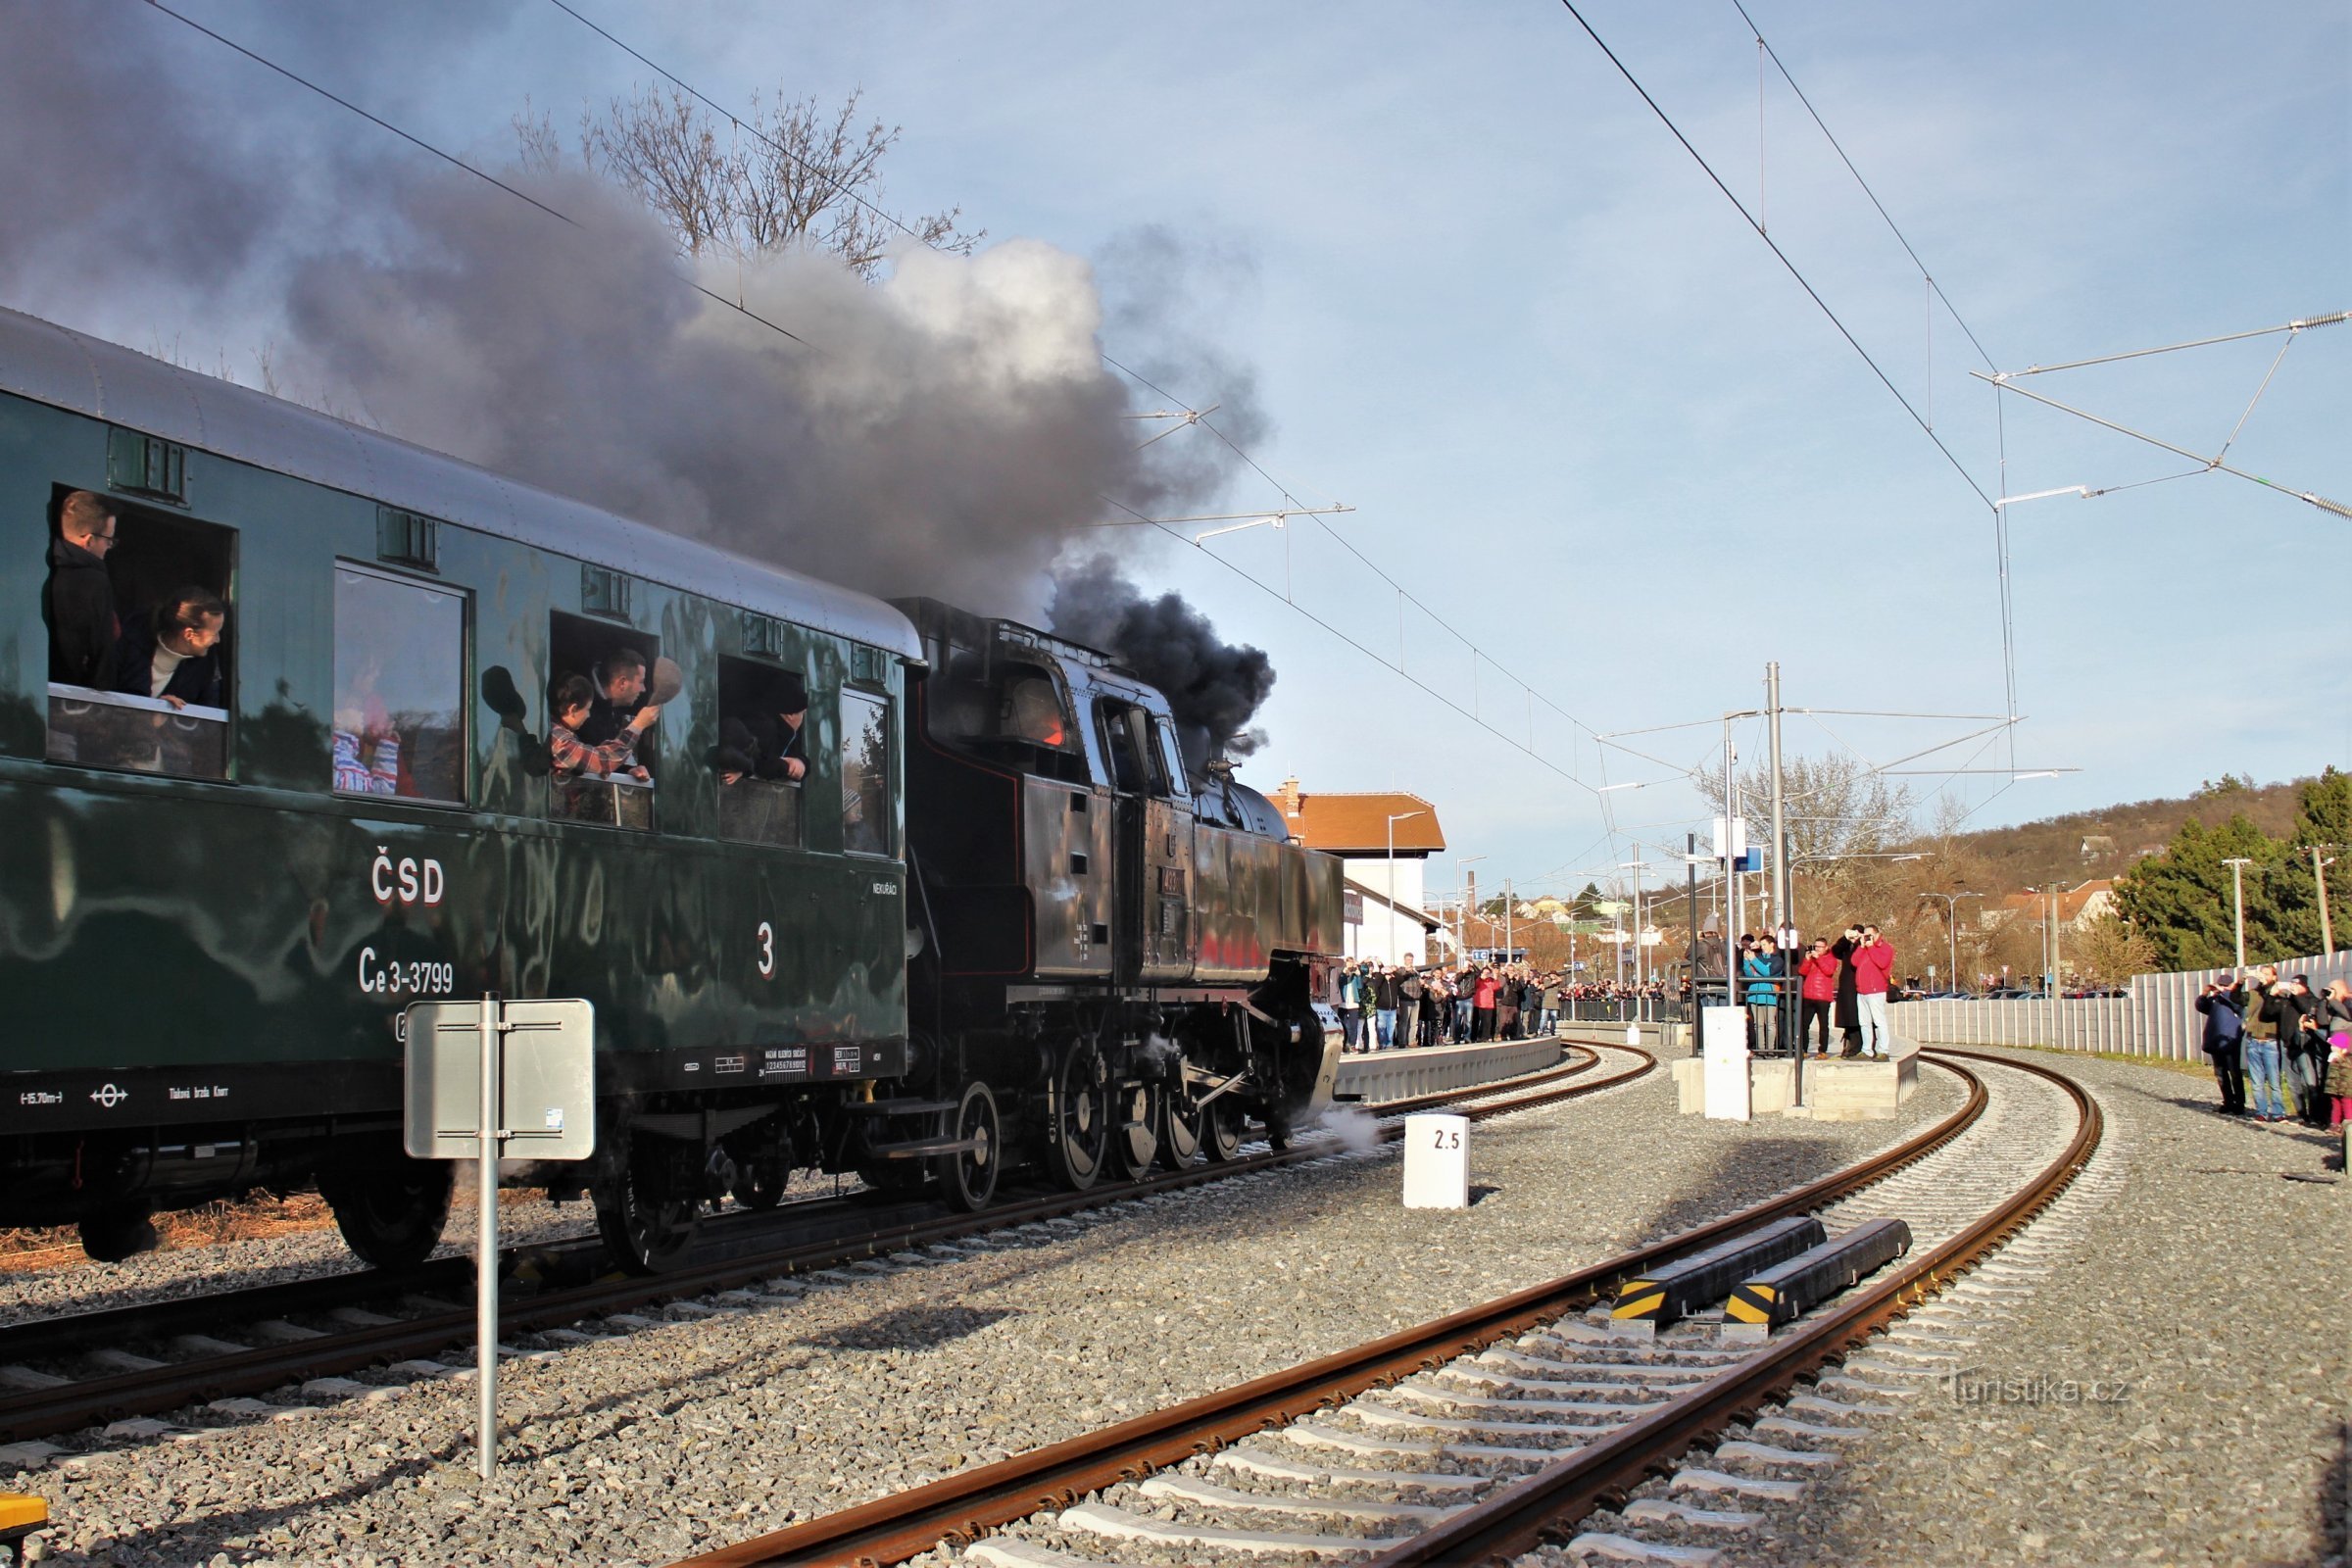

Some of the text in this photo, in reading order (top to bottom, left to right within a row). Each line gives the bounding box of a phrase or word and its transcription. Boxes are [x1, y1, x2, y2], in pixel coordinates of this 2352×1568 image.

[371, 846, 444, 906] ČSD
[757, 921, 776, 980] 3
[389, 961, 453, 994] 3-3799
[1434, 1129, 1459, 1150] 2.5
